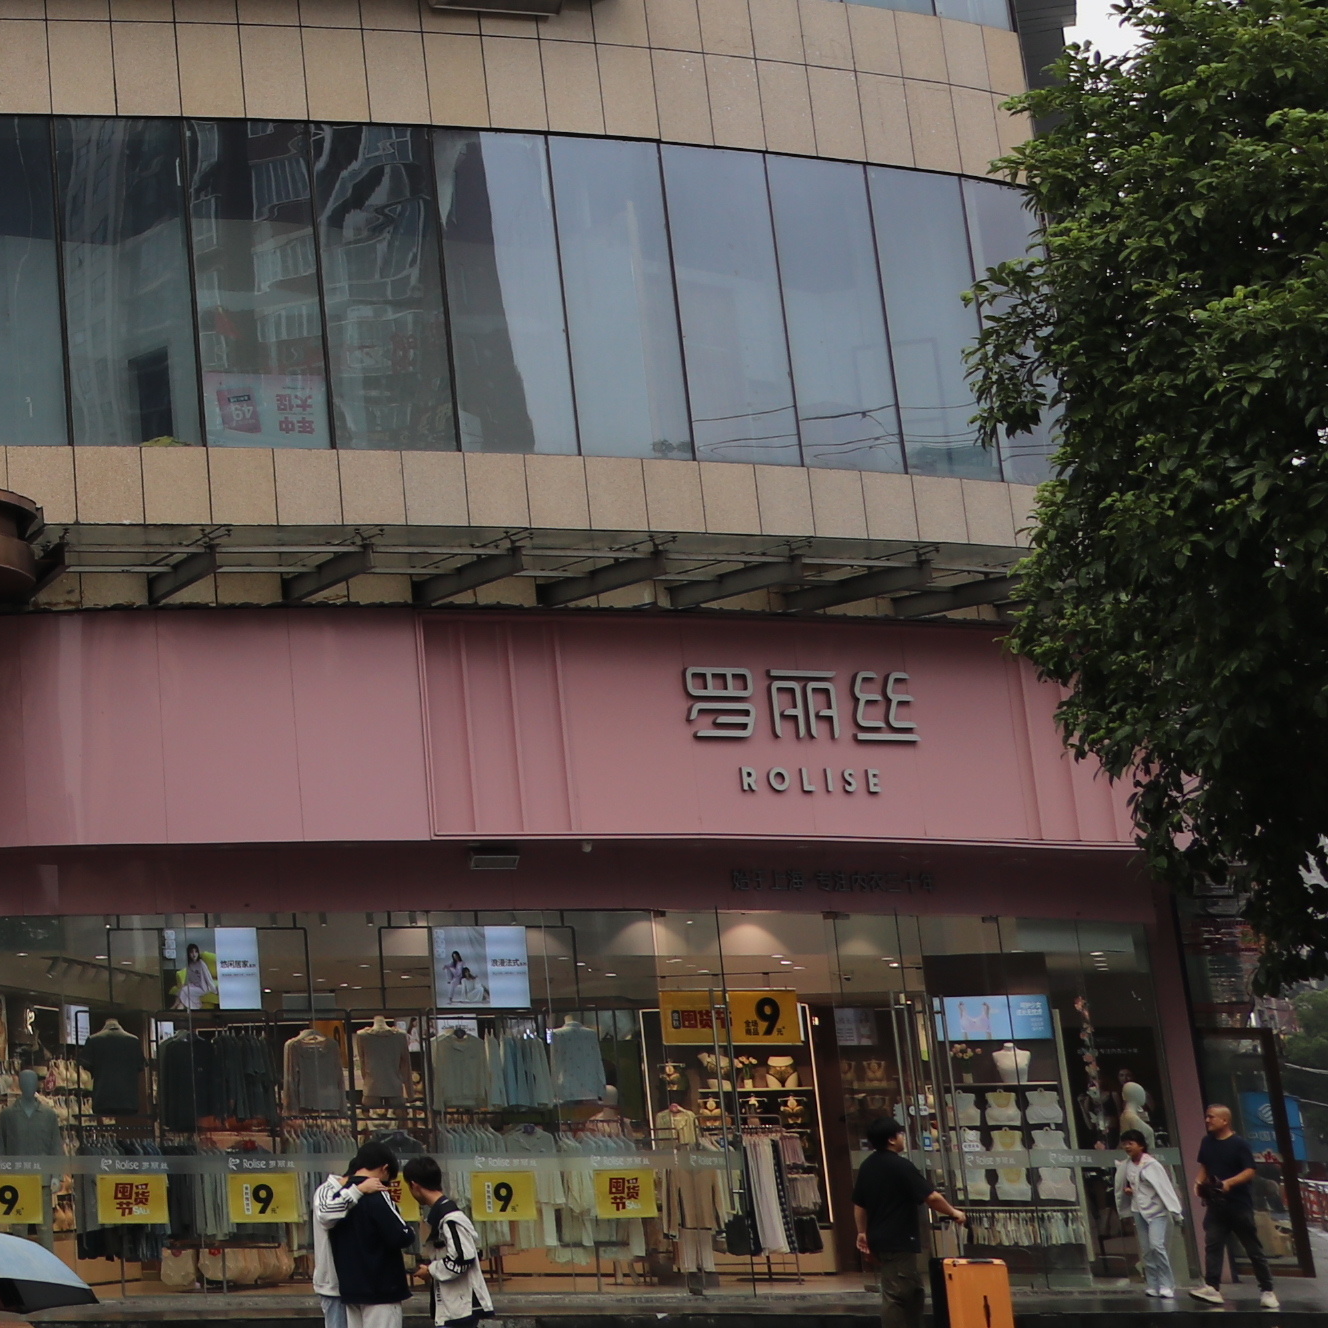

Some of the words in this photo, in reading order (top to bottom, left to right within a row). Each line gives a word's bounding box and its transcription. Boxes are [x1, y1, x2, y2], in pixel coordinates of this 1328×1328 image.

[682, 665, 922, 743] 罗丽丝
[739, 765, 882, 794] ROLISE
[115, 1158, 138, 1170] Rolise
[241, 1157, 265, 1169] Rolise
